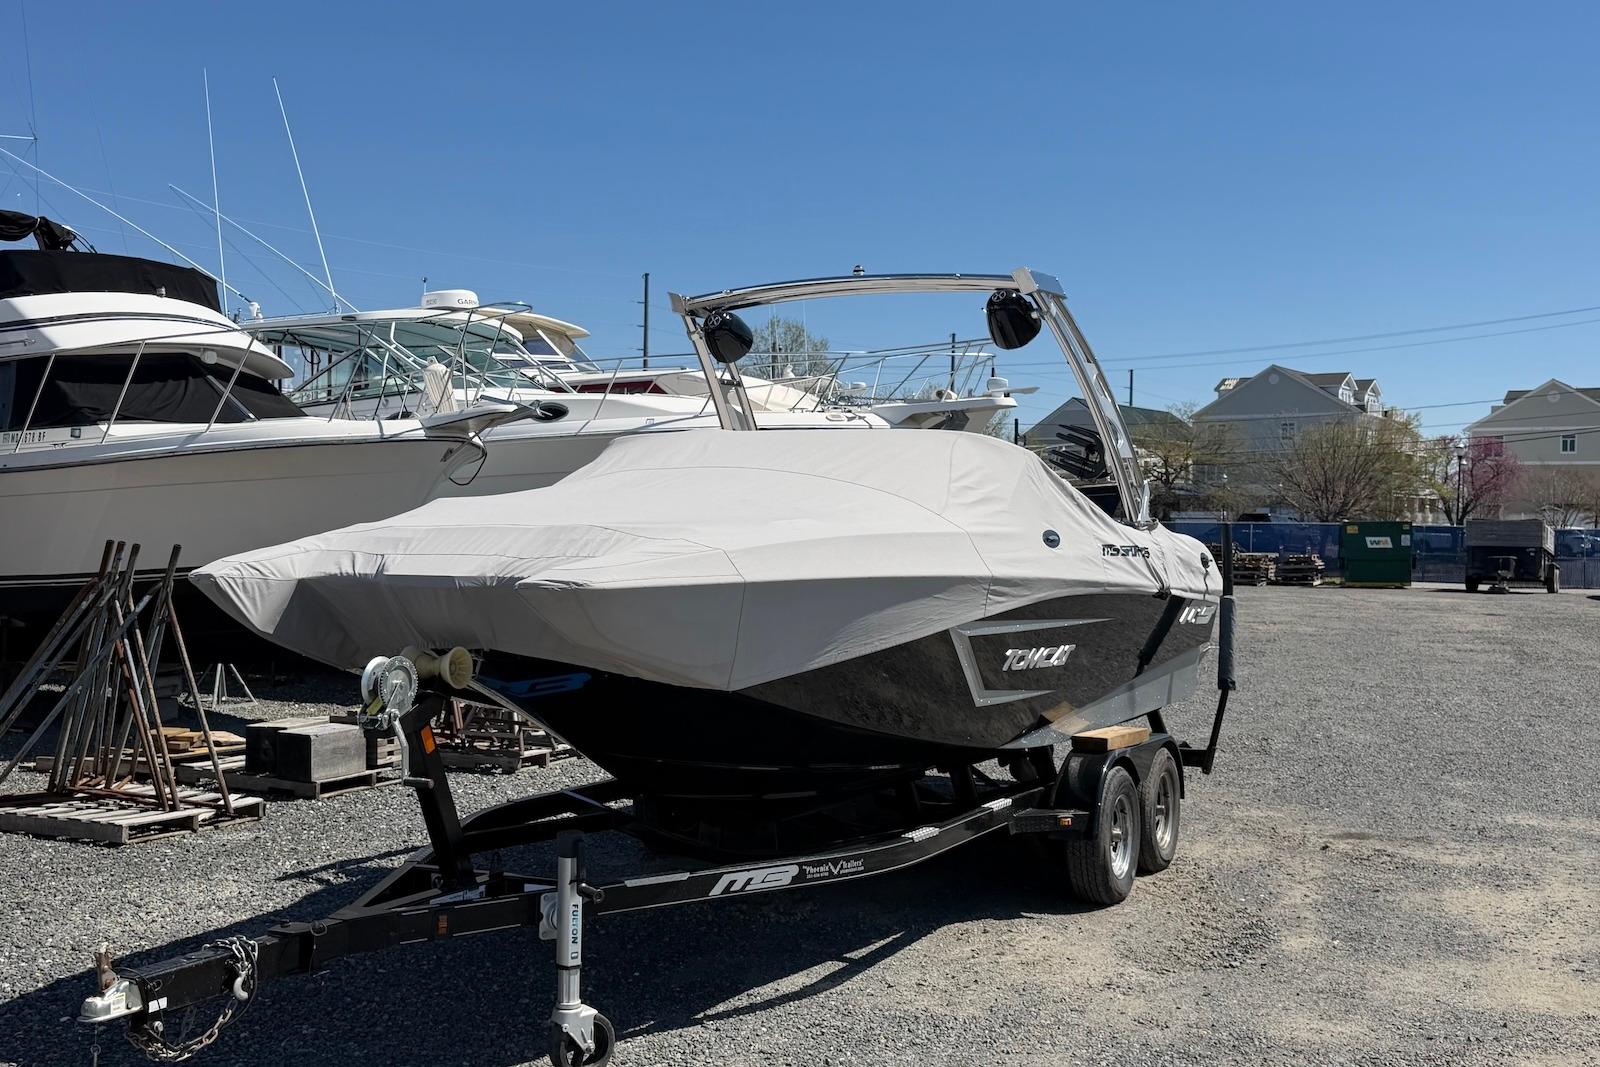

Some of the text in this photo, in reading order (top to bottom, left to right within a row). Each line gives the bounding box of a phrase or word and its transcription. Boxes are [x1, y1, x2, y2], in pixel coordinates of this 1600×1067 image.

[1002, 644, 1076, 672] TOMCAT
[708, 864, 799, 897] MB
[571, 903, 579, 945] FULTON
